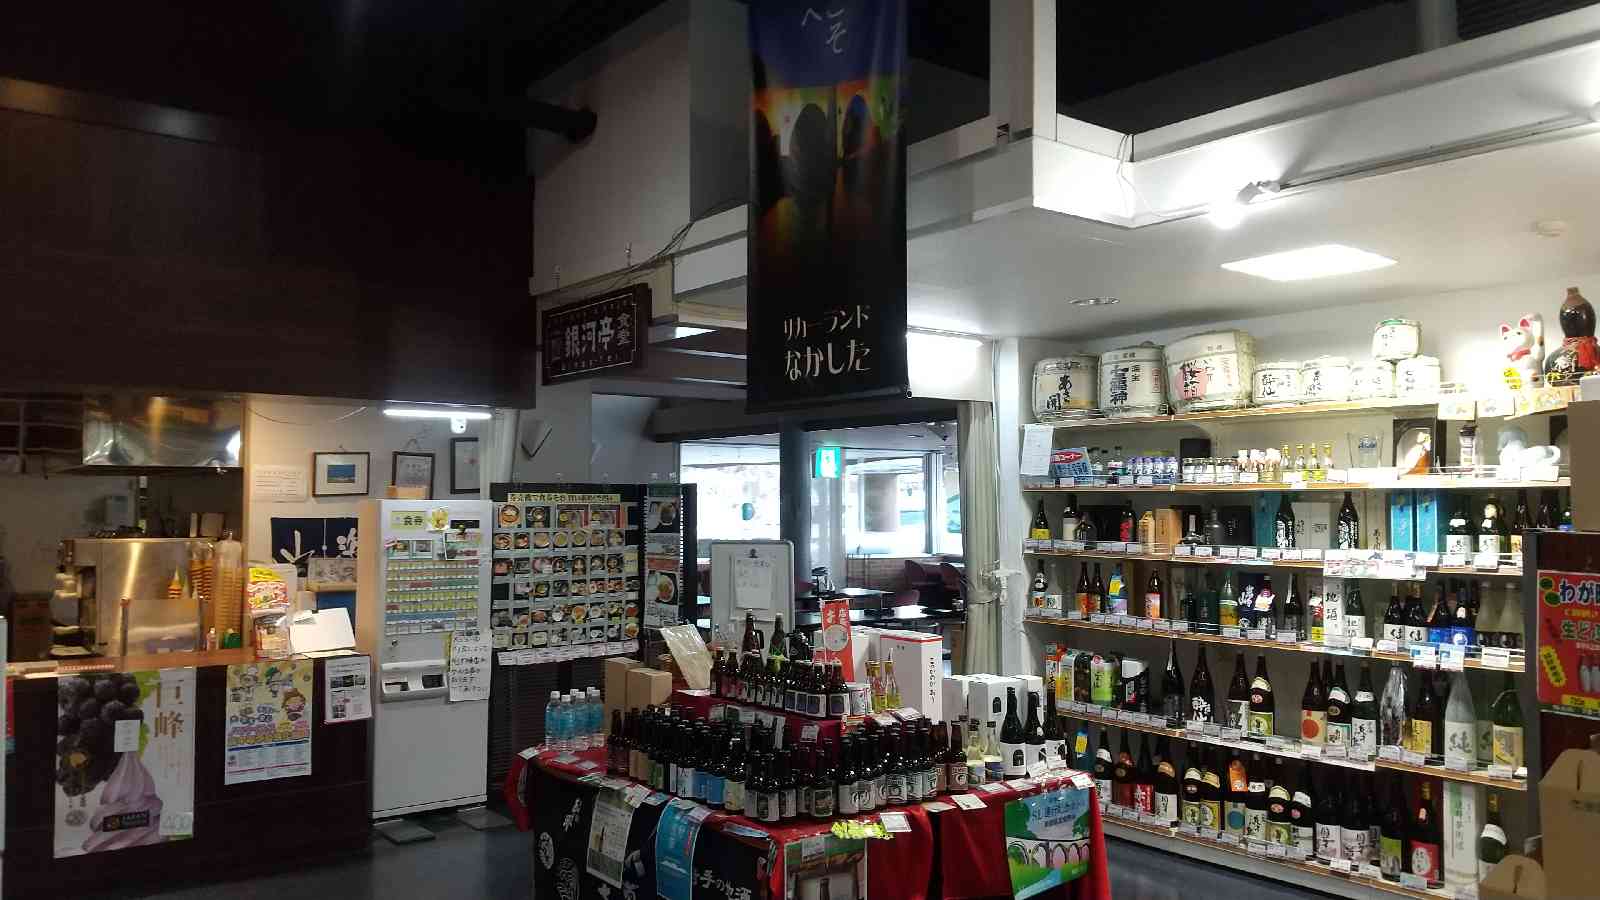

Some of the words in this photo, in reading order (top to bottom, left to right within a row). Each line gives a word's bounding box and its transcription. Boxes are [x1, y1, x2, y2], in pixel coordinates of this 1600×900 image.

[784, 304, 870, 341] リカーランド
[784, 339, 872, 381] なかした
[154, 679, 185, 738] 巨峰
